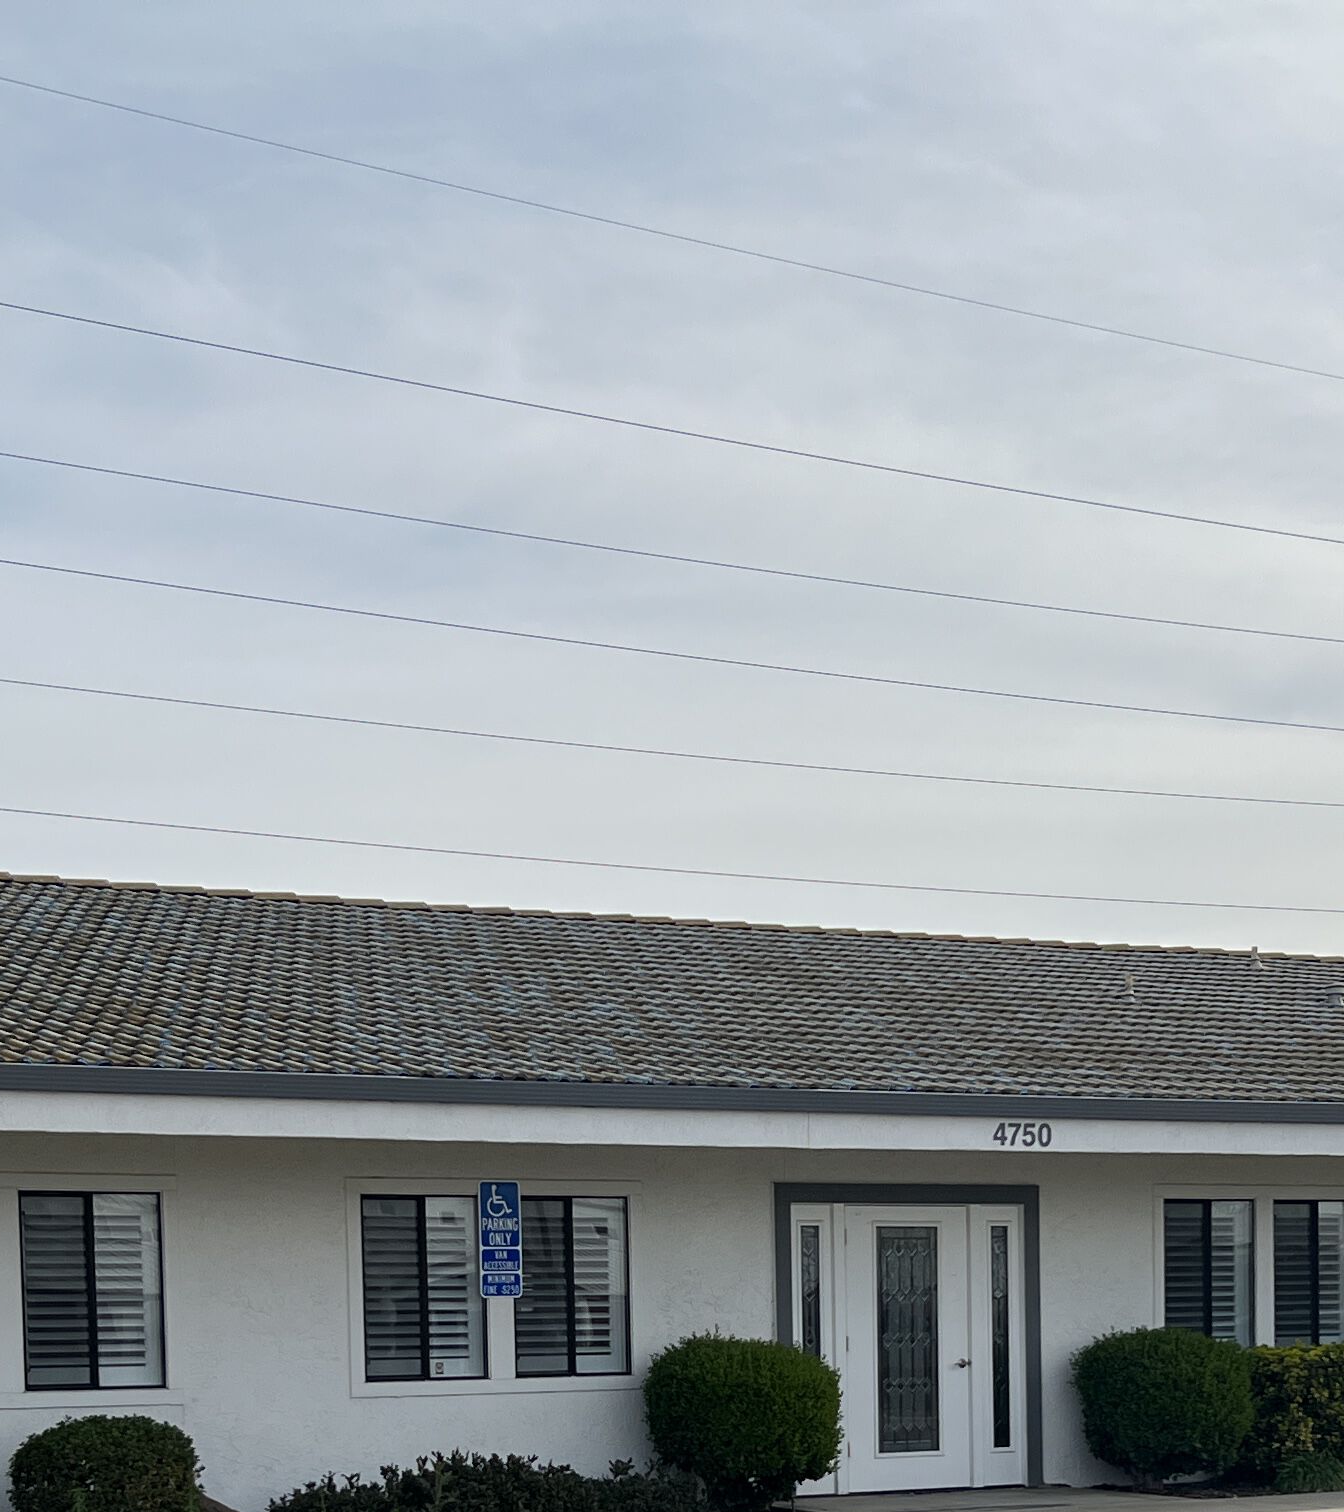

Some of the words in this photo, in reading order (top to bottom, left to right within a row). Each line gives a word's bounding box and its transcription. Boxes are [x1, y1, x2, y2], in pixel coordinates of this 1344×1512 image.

[993, 1122, 1052, 1147] 4750
[482, 1218, 518, 1231] PARKING
[489, 1232, 512, 1245] ONLY
[495, 1251, 507, 1259] VAN
[484, 1261, 518, 1270] ACCESSIBLE
[488, 1275, 515, 1283] MINIMUM
[484, 1285, 497, 1294] FINE
[502, 1285, 519, 1294] $250
